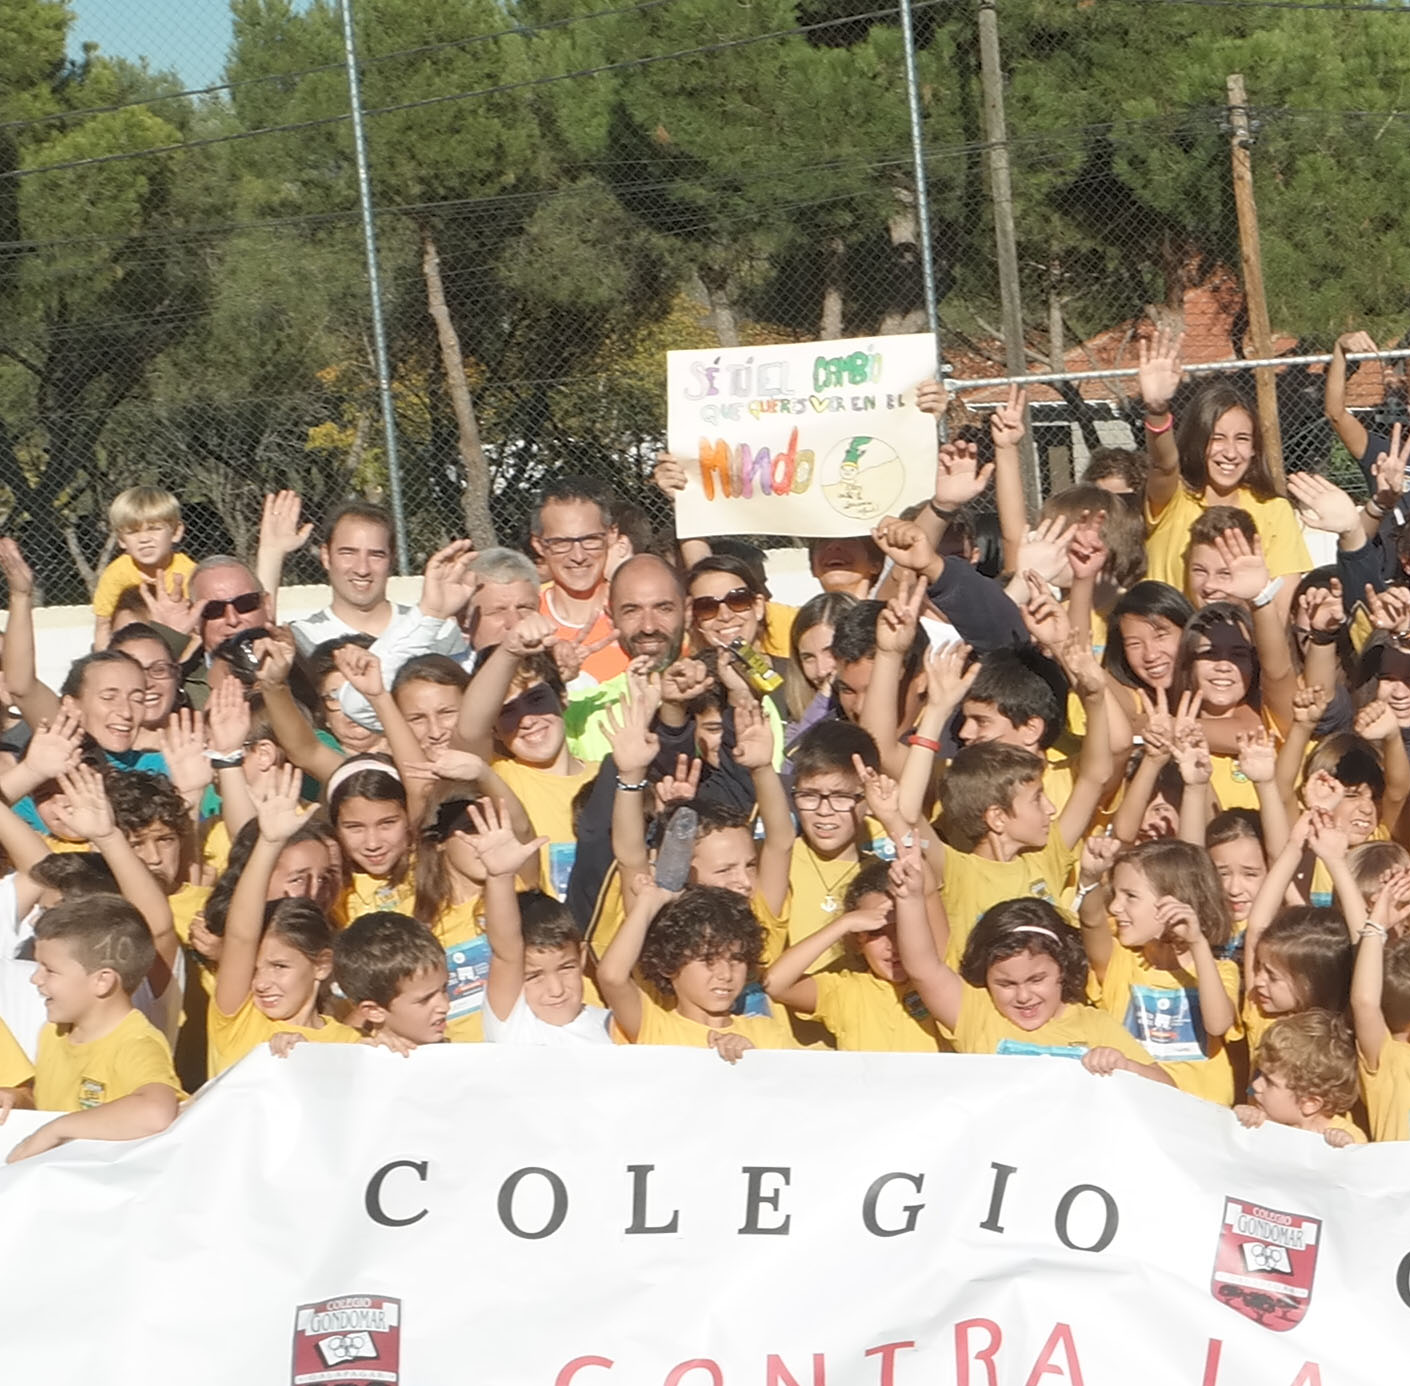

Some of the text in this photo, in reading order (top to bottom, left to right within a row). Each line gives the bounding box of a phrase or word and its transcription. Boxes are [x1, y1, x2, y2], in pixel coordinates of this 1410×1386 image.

[851, 395, 877, 412] EN
[886, 393, 906, 410] EL
[93, 933, 135, 964] 10
[364, 1159, 1120, 1253] COLEGIO
[1252, 1207, 1292, 1225] COLEGIO
[1238, 1213, 1305, 1249] GONDOMAR
[326, 1298, 373, 1311] COLEGIO
[310, 1310, 388, 1333] GONDOMAR
